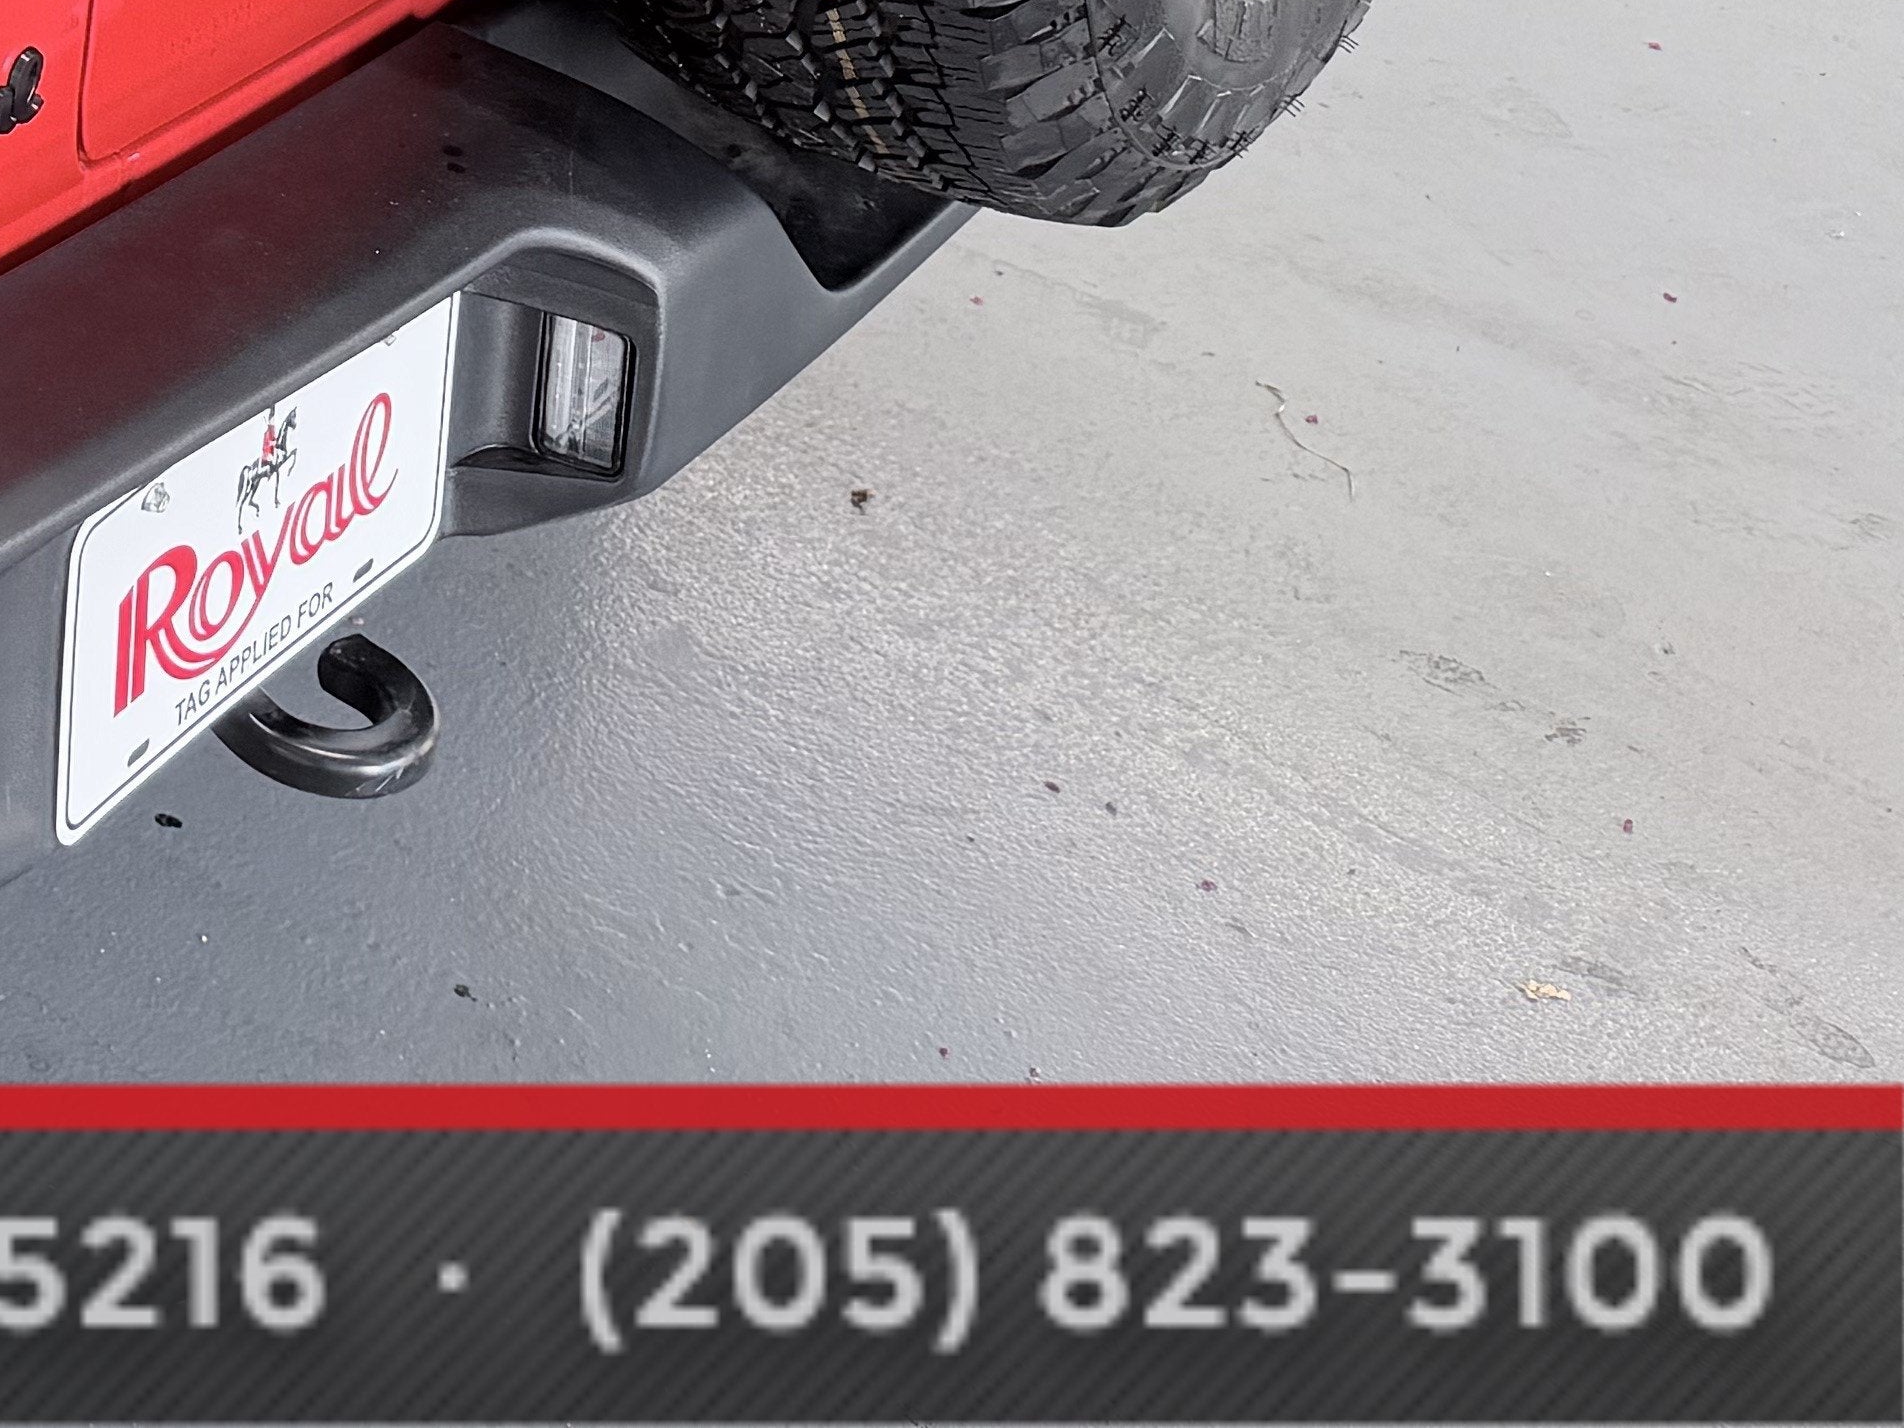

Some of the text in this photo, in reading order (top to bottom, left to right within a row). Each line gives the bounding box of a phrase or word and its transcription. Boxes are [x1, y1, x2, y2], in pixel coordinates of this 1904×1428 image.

[113, 393, 398, 717] Royal
[175, 581, 334, 726] TAG APPLIED FOR
